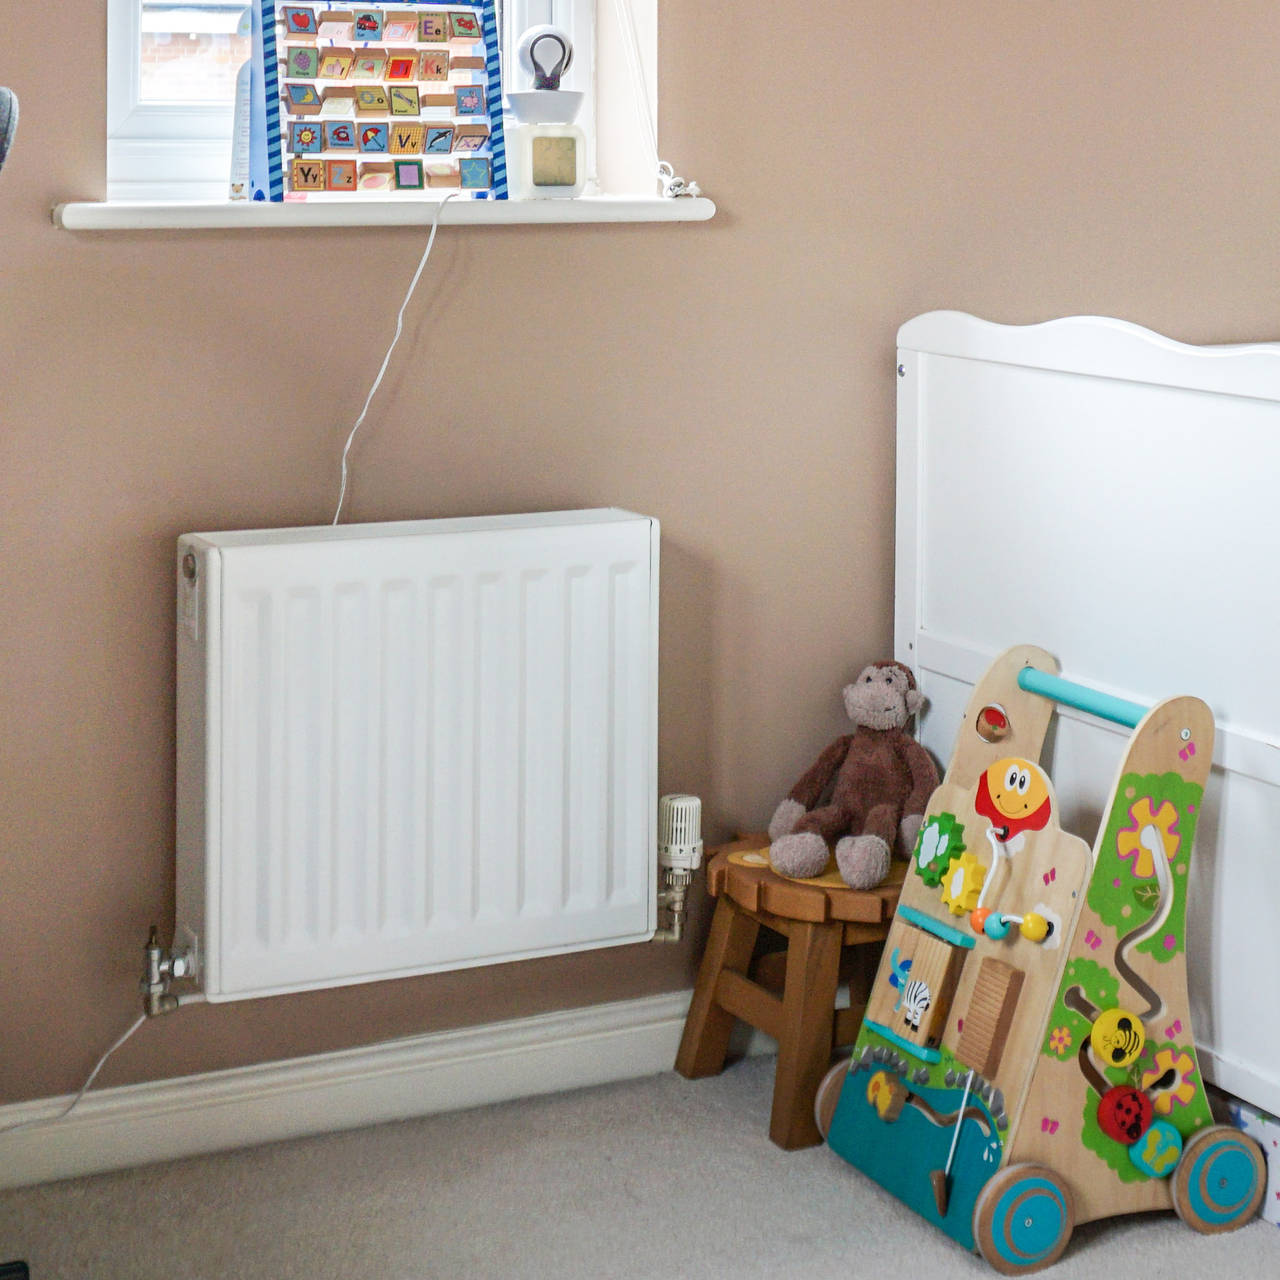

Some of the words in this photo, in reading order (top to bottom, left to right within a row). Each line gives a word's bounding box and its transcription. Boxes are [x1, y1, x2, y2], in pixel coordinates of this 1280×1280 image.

[423, 20, 441, 36] Ee
[424, 58, 442, 74] Kk
[398, 134, 417, 148] Vv
[300, 167, 318, 184] Yy
[332, 167, 352, 184] Zz
